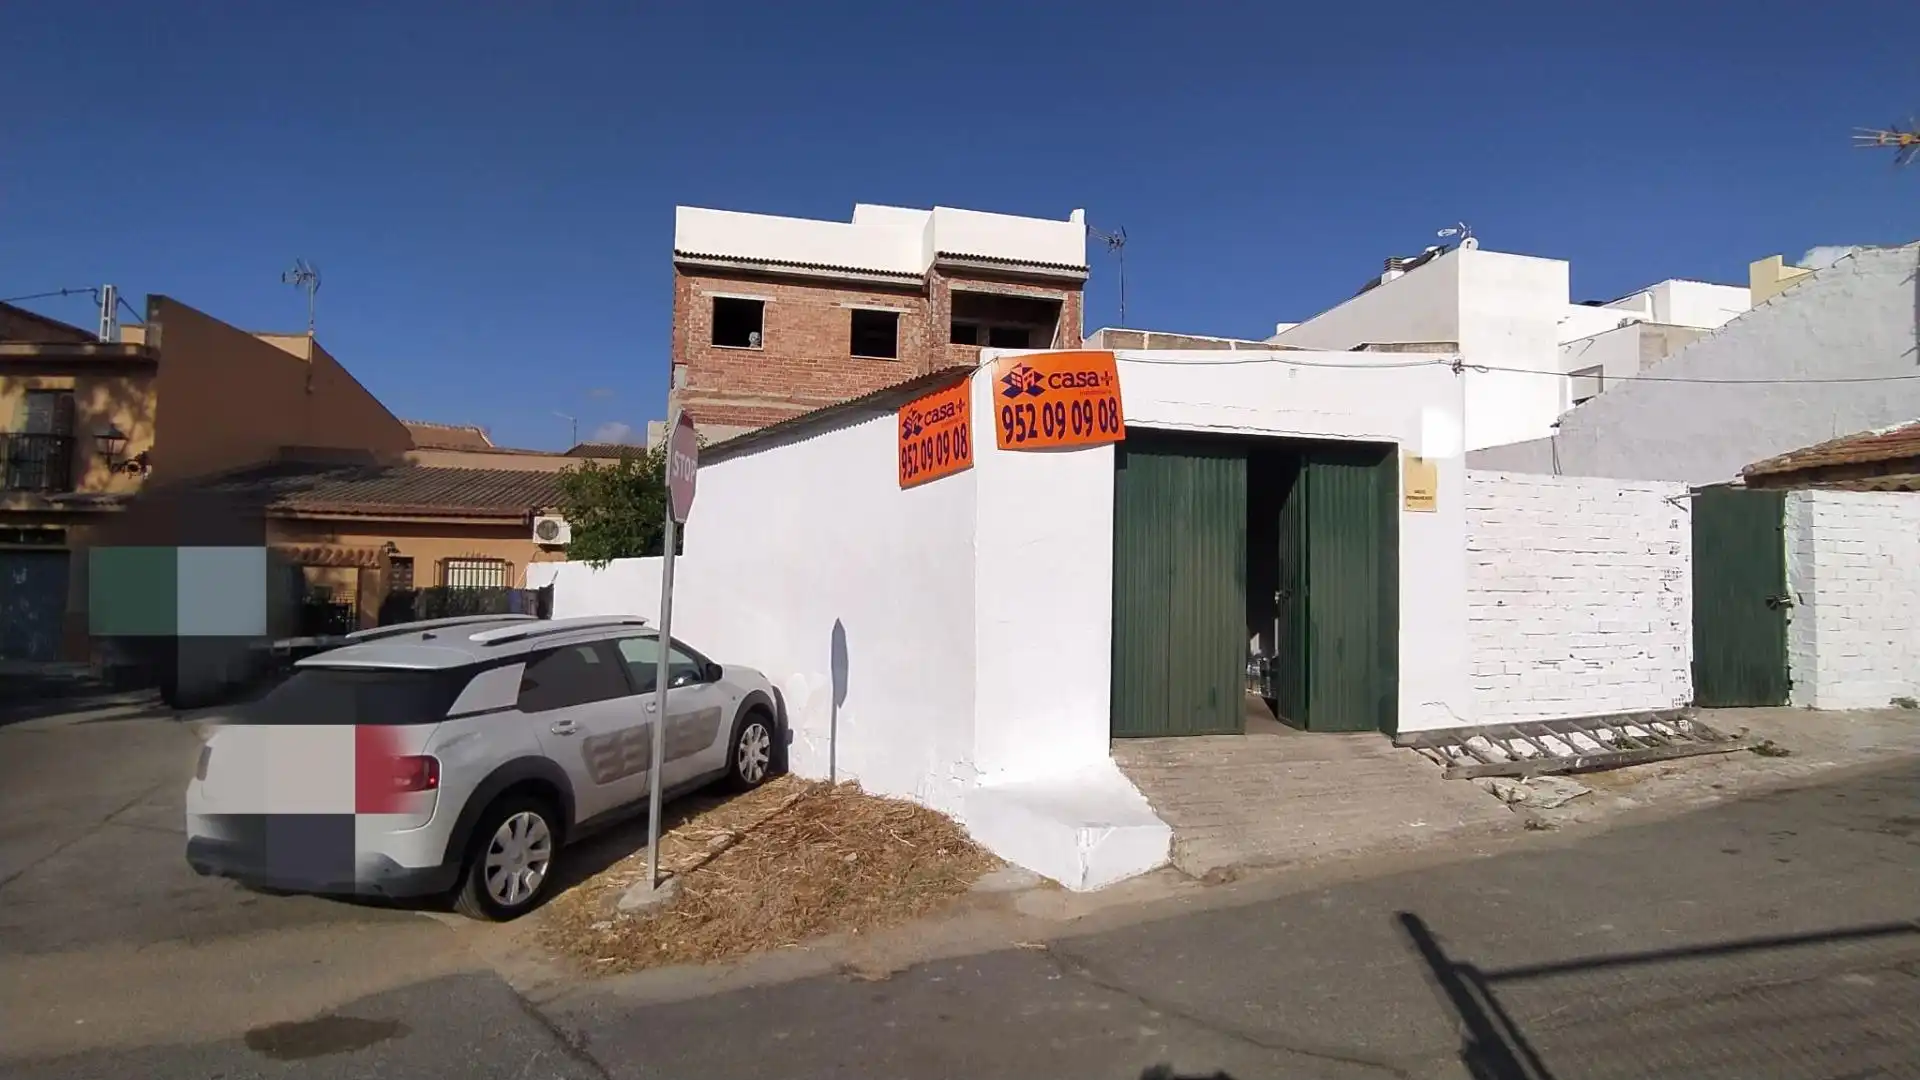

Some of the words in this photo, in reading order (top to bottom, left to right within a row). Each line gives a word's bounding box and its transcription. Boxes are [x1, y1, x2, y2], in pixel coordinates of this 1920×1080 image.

[1002, 403, 1038, 444] 952
[1042, 401, 1066, 440] 09
[1071, 400, 1093, 437] 09
[1098, 396, 1119, 434] 08
[674, 450, 697, 482] STOP
[901, 442, 919, 480] 952
[920, 436, 934, 472] 09
[936, 430, 950, 466] 09
[953, 422, 968, 460] 08
